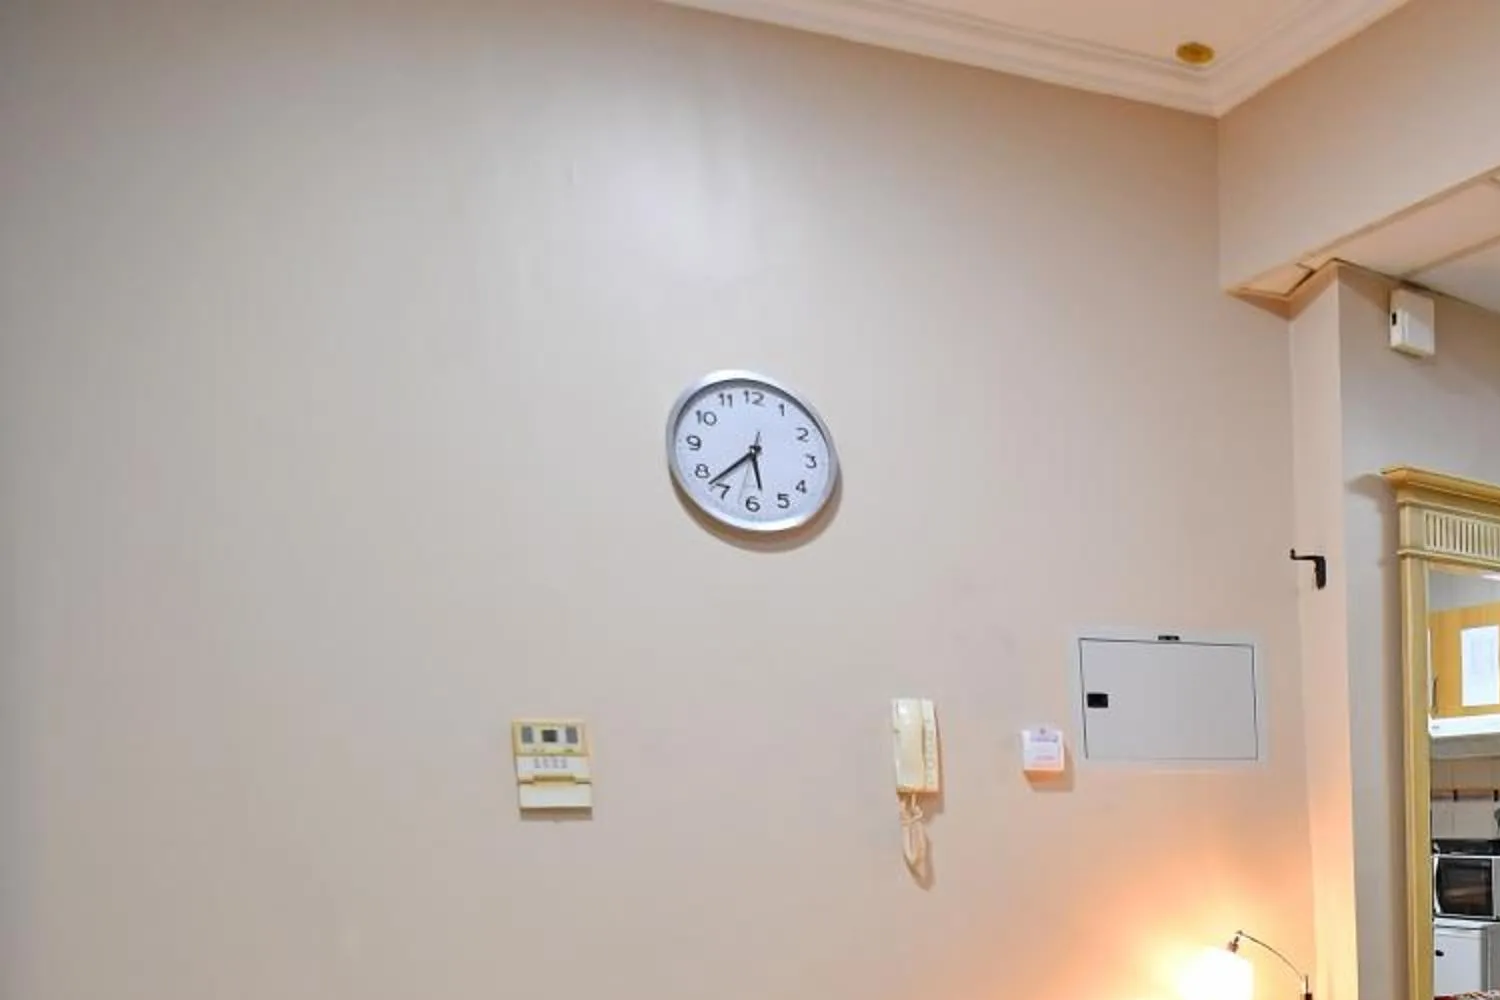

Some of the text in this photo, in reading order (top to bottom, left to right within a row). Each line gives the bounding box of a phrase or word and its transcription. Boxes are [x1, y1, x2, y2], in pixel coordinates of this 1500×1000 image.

[718, 393, 733, 407] 11
[743, 390, 765, 406] 12
[778, 403, 785, 416] 1
[695, 410, 718, 426] 10
[686, 434, 702, 451] 9
[796, 427, 810, 443] 2
[805, 454, 817, 469] 3
[694, 463, 710, 479] 8
[715, 483, 731, 500] 7
[795, 480, 807, 494] 4
[745, 495, 761, 512] 6
[777, 493, 791, 510] 5
